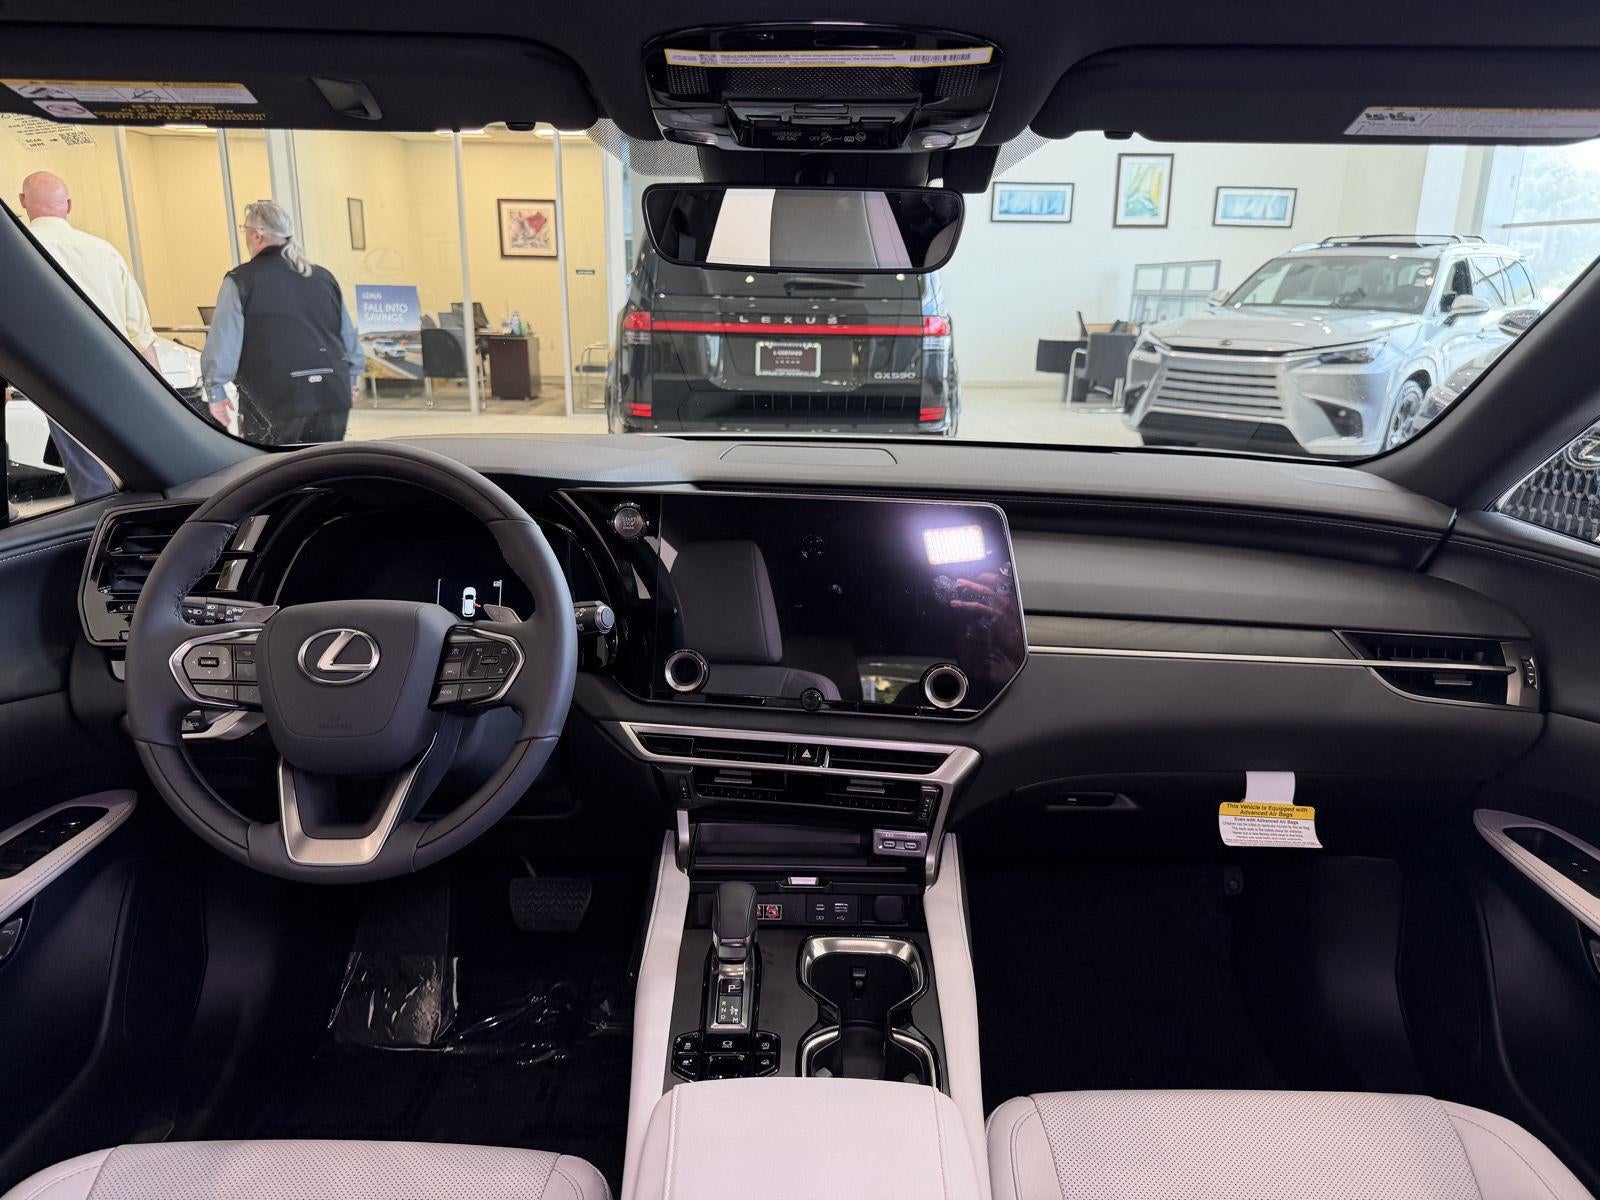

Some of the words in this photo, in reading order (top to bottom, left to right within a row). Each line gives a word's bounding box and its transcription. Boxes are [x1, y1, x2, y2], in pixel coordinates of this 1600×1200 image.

[363, 303, 382, 313] FALL
[385, 303, 408, 313] INTO
[364, 313, 405, 323] SAVINGS
[739, 316, 838, 324] LEXUS
